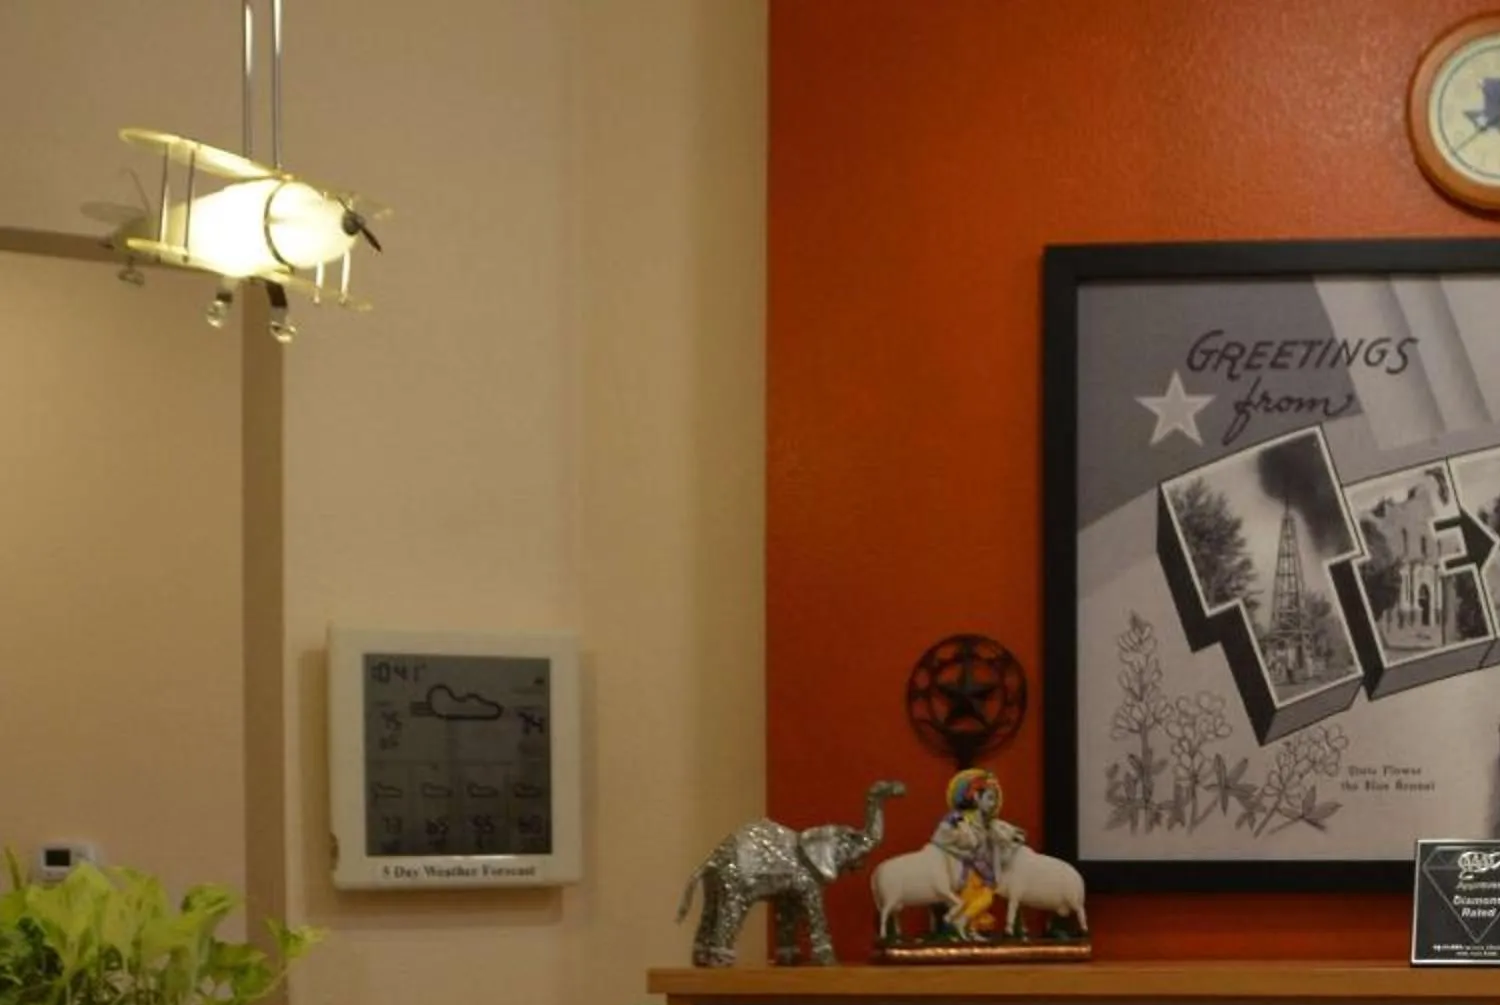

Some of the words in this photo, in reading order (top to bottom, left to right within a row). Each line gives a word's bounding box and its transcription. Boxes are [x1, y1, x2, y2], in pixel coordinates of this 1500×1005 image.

[1186, 329, 1419, 381] GREETINGS
[1222, 376, 1356, 446] from
[394, 865, 419, 878] Day
[424, 865, 478, 877] Weather
[1461, 907, 1496, 918] Rated
